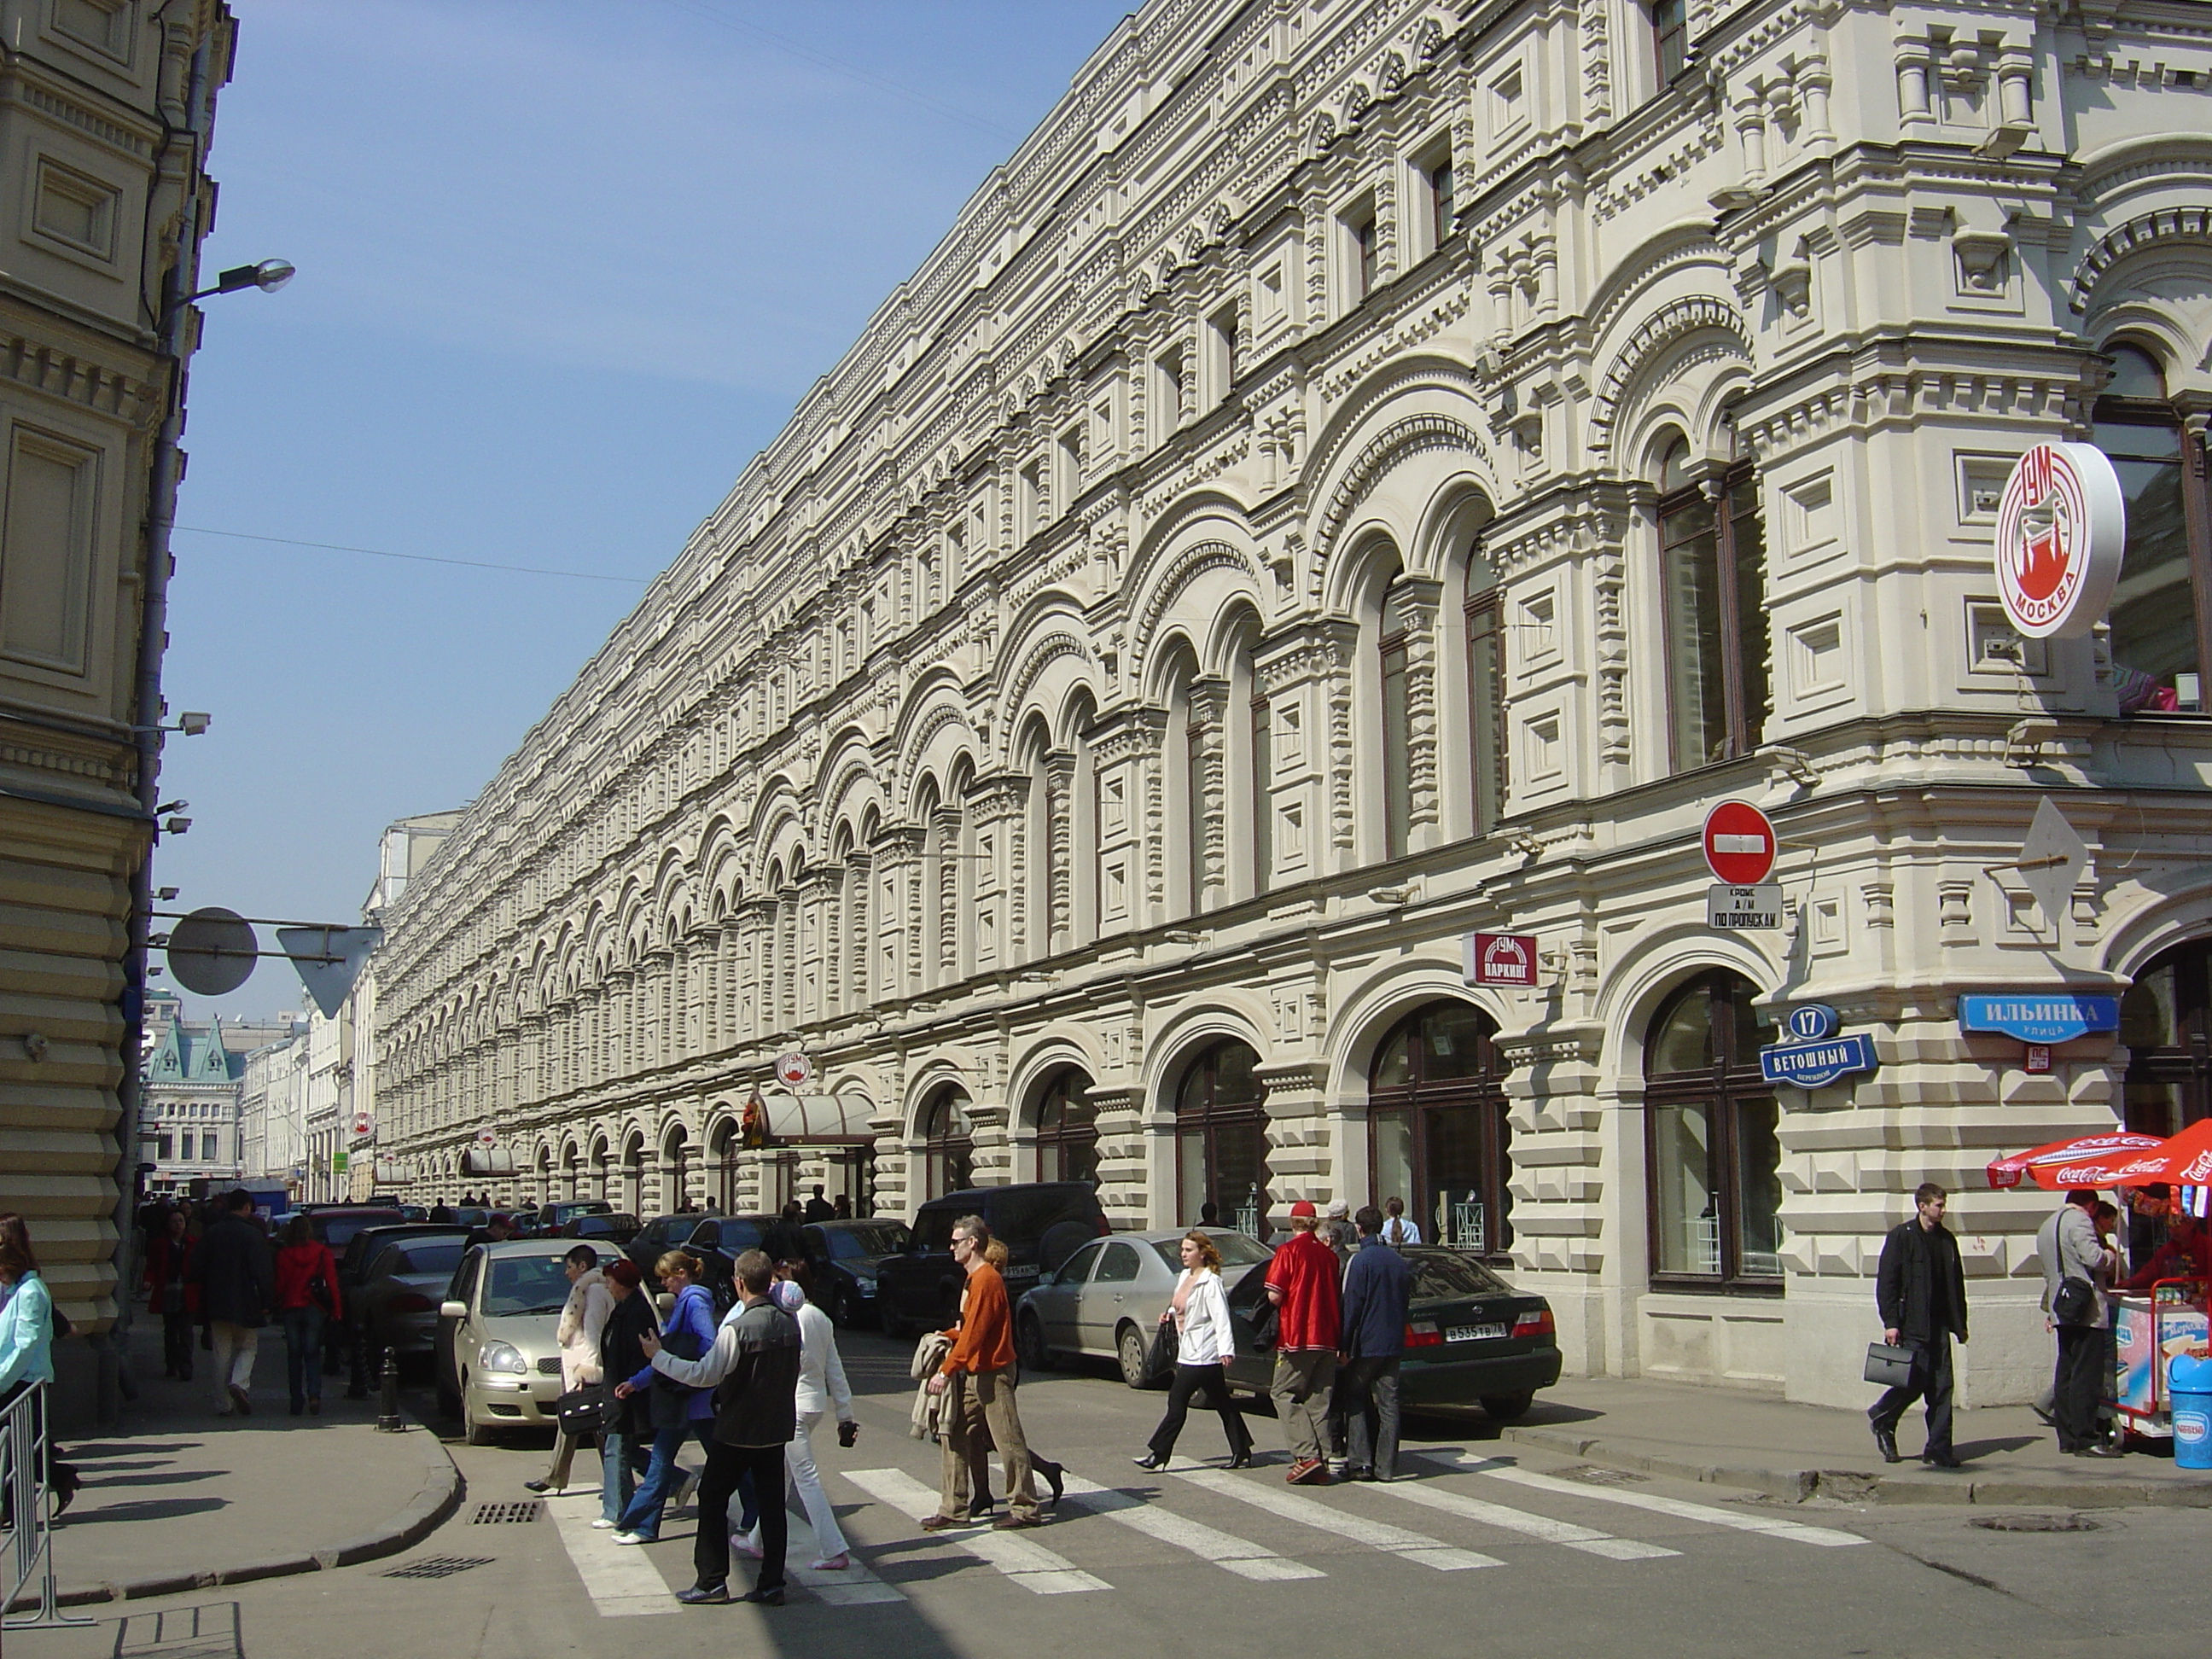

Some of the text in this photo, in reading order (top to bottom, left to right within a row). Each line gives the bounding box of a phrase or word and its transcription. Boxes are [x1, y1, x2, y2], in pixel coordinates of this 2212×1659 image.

[2020, 445, 2053, 507] ГУМ
[2015, 571, 2075, 619] МОСКВА
[1729, 888, 1755, 897] КРОМЕ
[1714, 912, 1776, 928] ПО ПРОПУСКАМ
[1496, 936, 1515, 953] ГУМ
[1485, 963, 1528, 979] ПАРКИНГ
[1985, 1004, 2099, 1022] ИЛЬИНКА
[1799, 1011, 1816, 1034] 17
[2023, 1025, 2065, 1037] УЛИЦА
[1773, 1045, 1848, 1073] ВЕТОШНЫЙ
